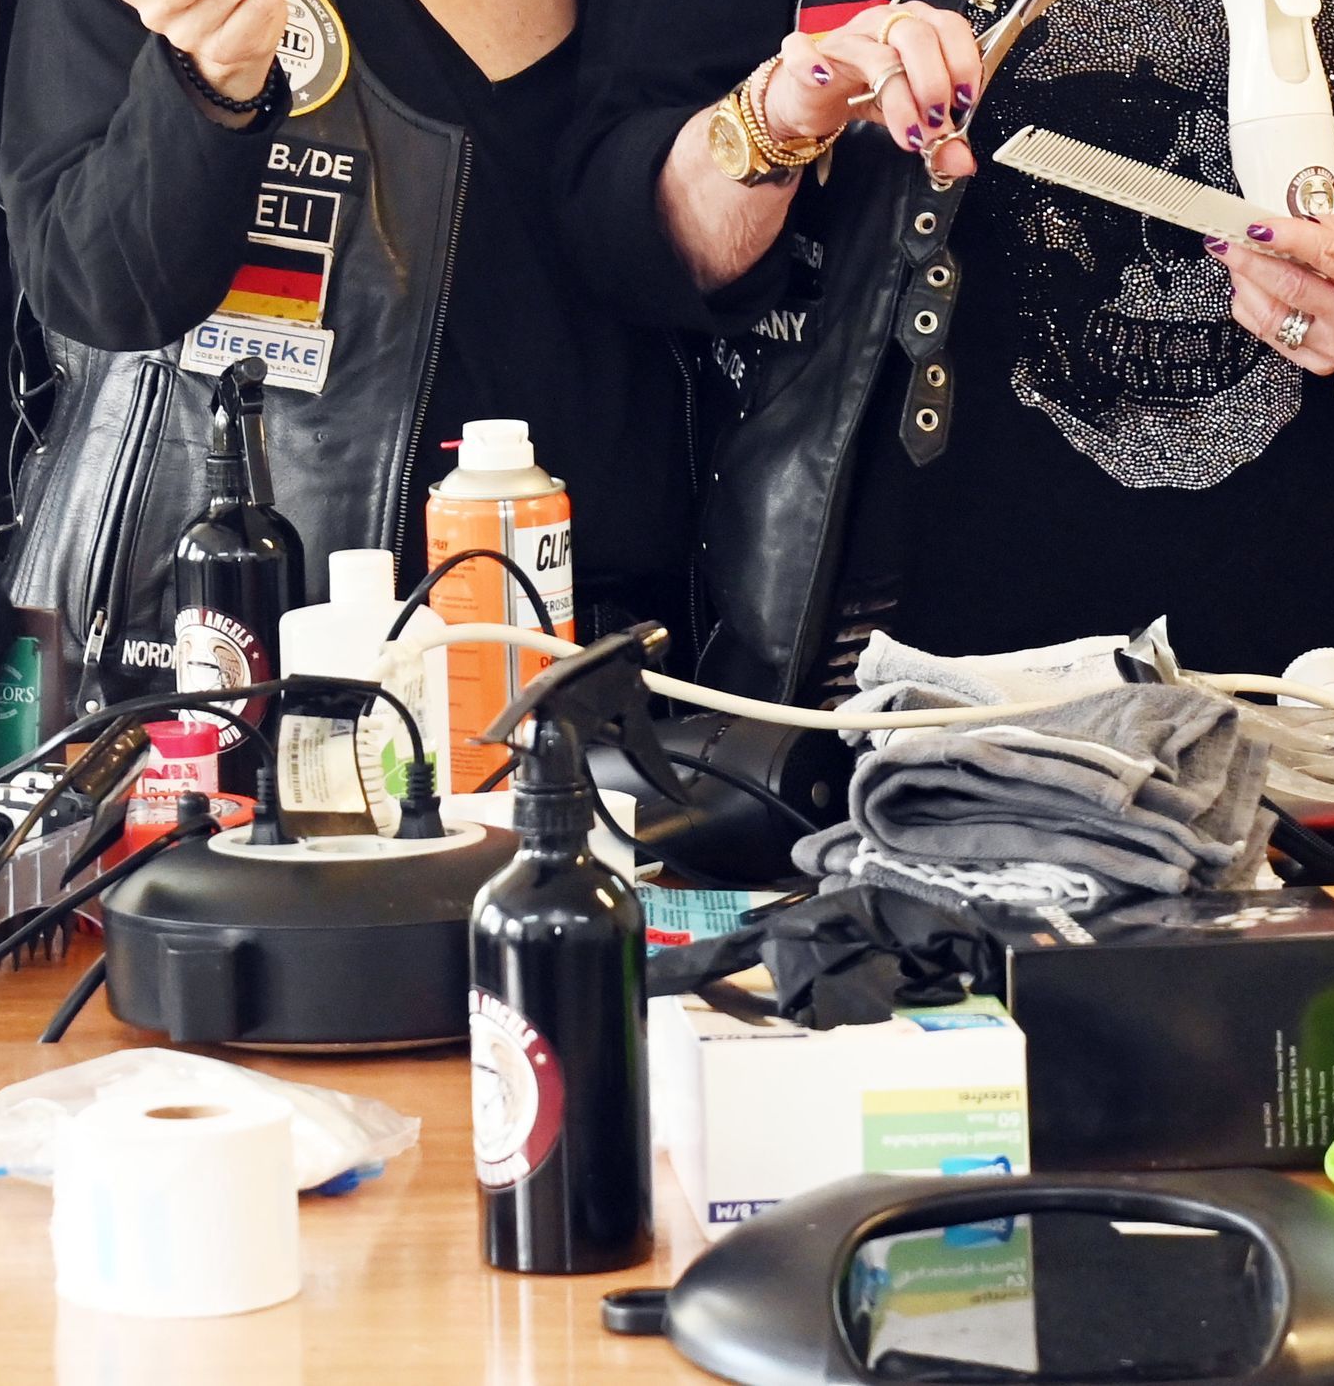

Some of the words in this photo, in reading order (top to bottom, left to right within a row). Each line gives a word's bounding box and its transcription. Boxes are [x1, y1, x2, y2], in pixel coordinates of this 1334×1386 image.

[267, 142, 354, 183] B./DE
[204, 609, 255, 650] ANGELS
[957, 1089, 1021, 1104] Latexfrei
[715, 1204, 752, 1220] 8/M
